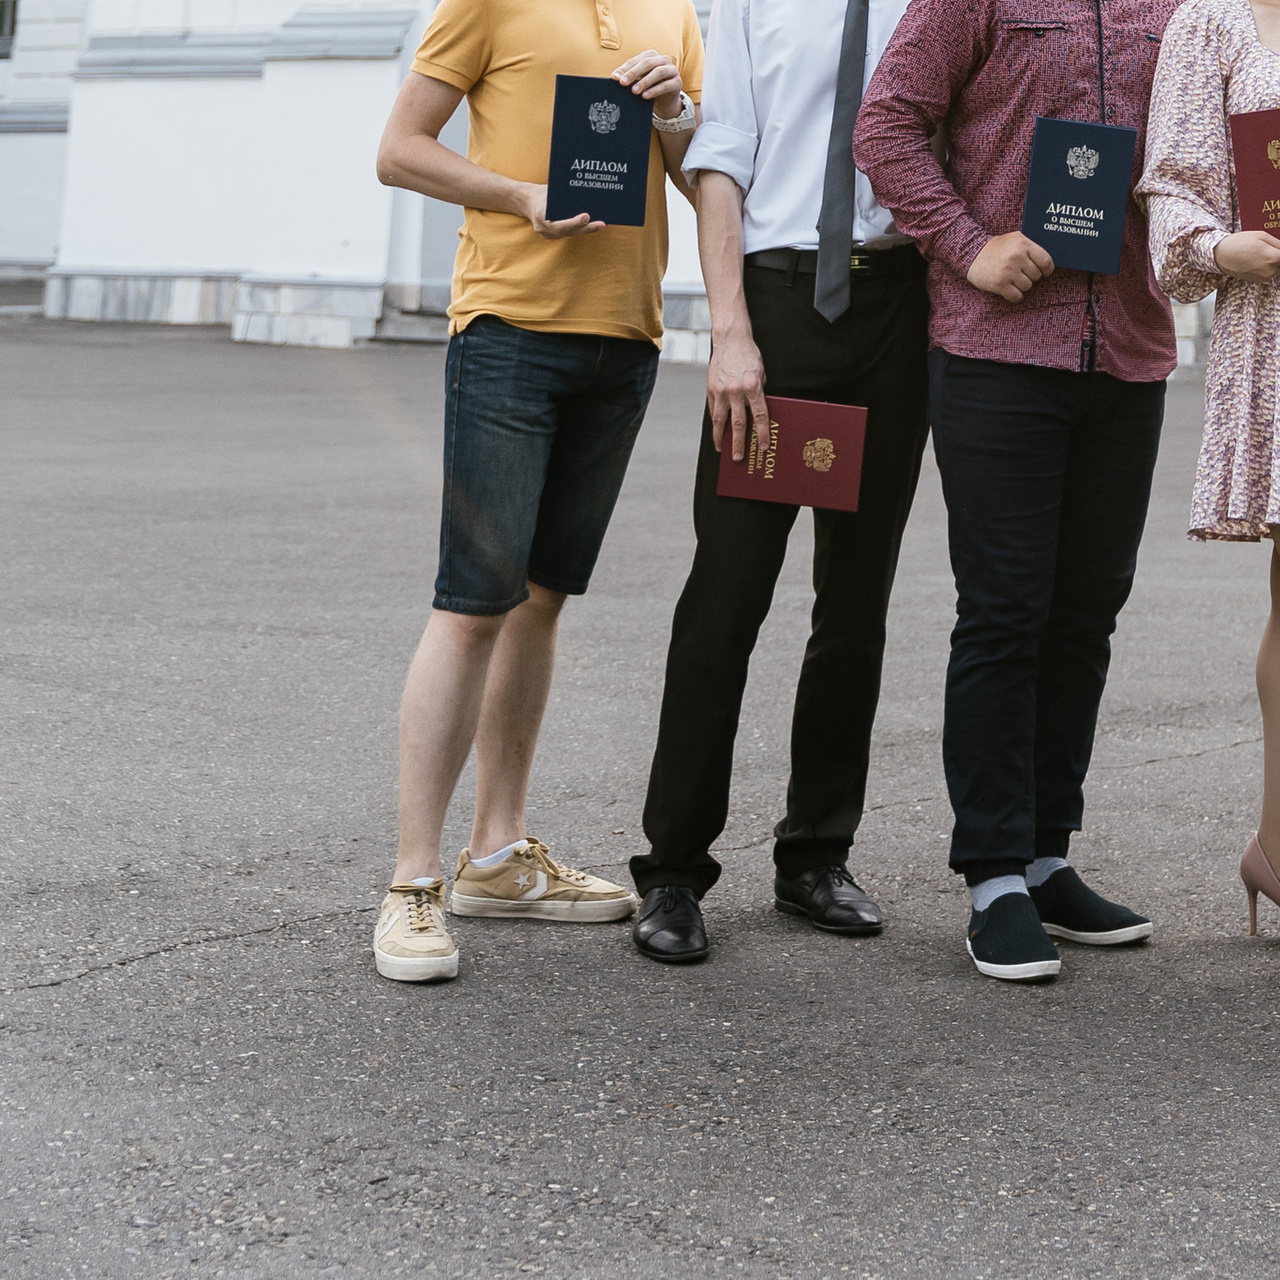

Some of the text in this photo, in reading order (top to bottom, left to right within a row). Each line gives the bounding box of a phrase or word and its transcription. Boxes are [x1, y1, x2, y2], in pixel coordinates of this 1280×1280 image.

[570, 159, 628, 173] ДИПЛОМ
[584, 173, 618, 182] ВЫСШЕМ
[569, 180, 624, 190] ОБРАЗОВАНИИ
[1046, 202, 1104, 220] ДИПЛОМ
[1059, 217, 1094, 228] ВЫСШЕМ
[1043, 223, 1099, 237] ОБРАЗОВАНИИ
